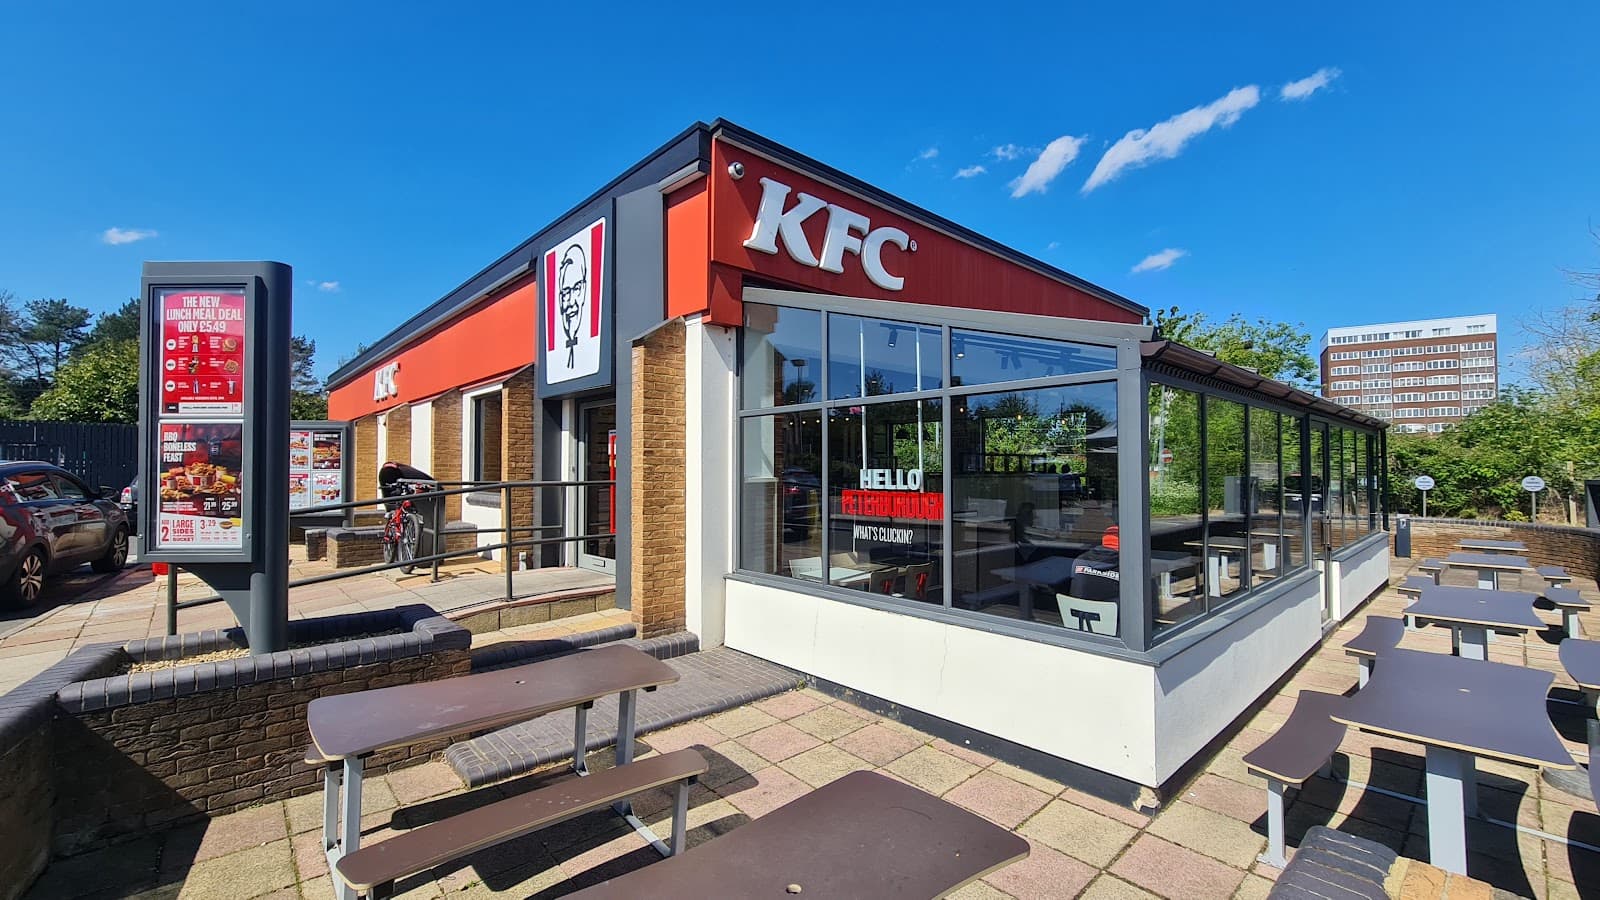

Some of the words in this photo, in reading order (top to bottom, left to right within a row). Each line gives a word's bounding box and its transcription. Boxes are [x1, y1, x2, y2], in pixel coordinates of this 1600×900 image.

[743, 177, 909, 291] KFC
[182, 296, 198, 308] THE
[199, 296, 220, 308] NEW
[166, 308, 191, 320] LUNCH
[192, 308, 217, 320] MEAL
[218, 308, 243, 320] DEAL
[178, 321, 198, 333] ONLY
[373, 361, 399, 400] KFC
[163, 432, 178, 442] BBQ
[163, 442, 197, 452] BONELESS
[163, 453, 183, 463] FEAST
[860, 469, 920, 490] HELLO
[842, 489, 944, 520] PETERBOROUGH
[172, 519, 194, 529] LARGE
[161, 526, 170, 542] 2
[853, 525, 878, 541] WHAT'S
[879, 527, 914, 545] CLUCKIN?
